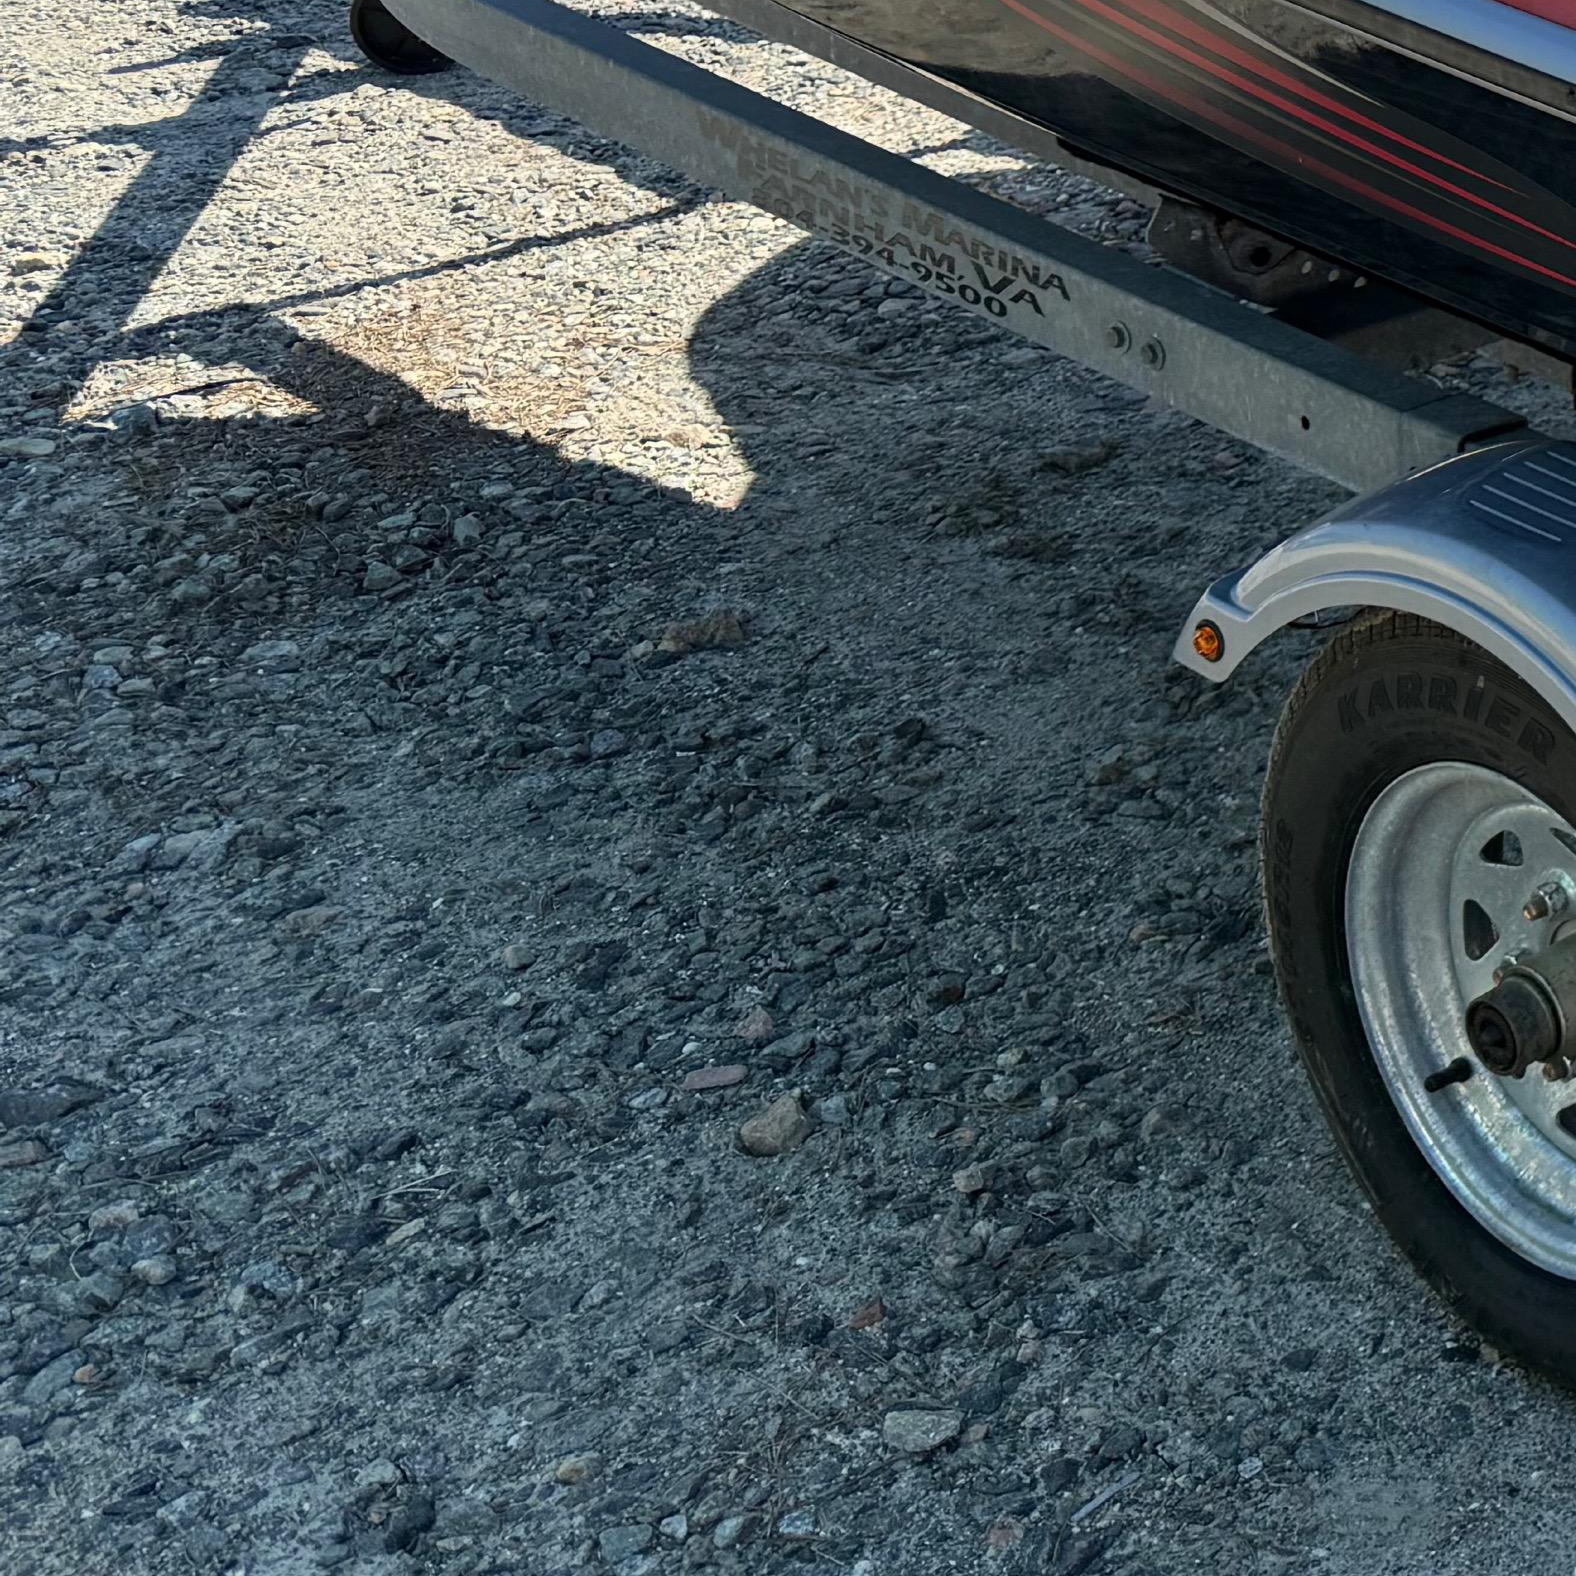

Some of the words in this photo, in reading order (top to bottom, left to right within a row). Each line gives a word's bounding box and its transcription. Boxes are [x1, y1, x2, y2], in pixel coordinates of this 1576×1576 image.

[903, 198, 1071, 302] MARINA
[971, 260, 1046, 319] VA
[1336, 671, 1557, 766] KARRIER
